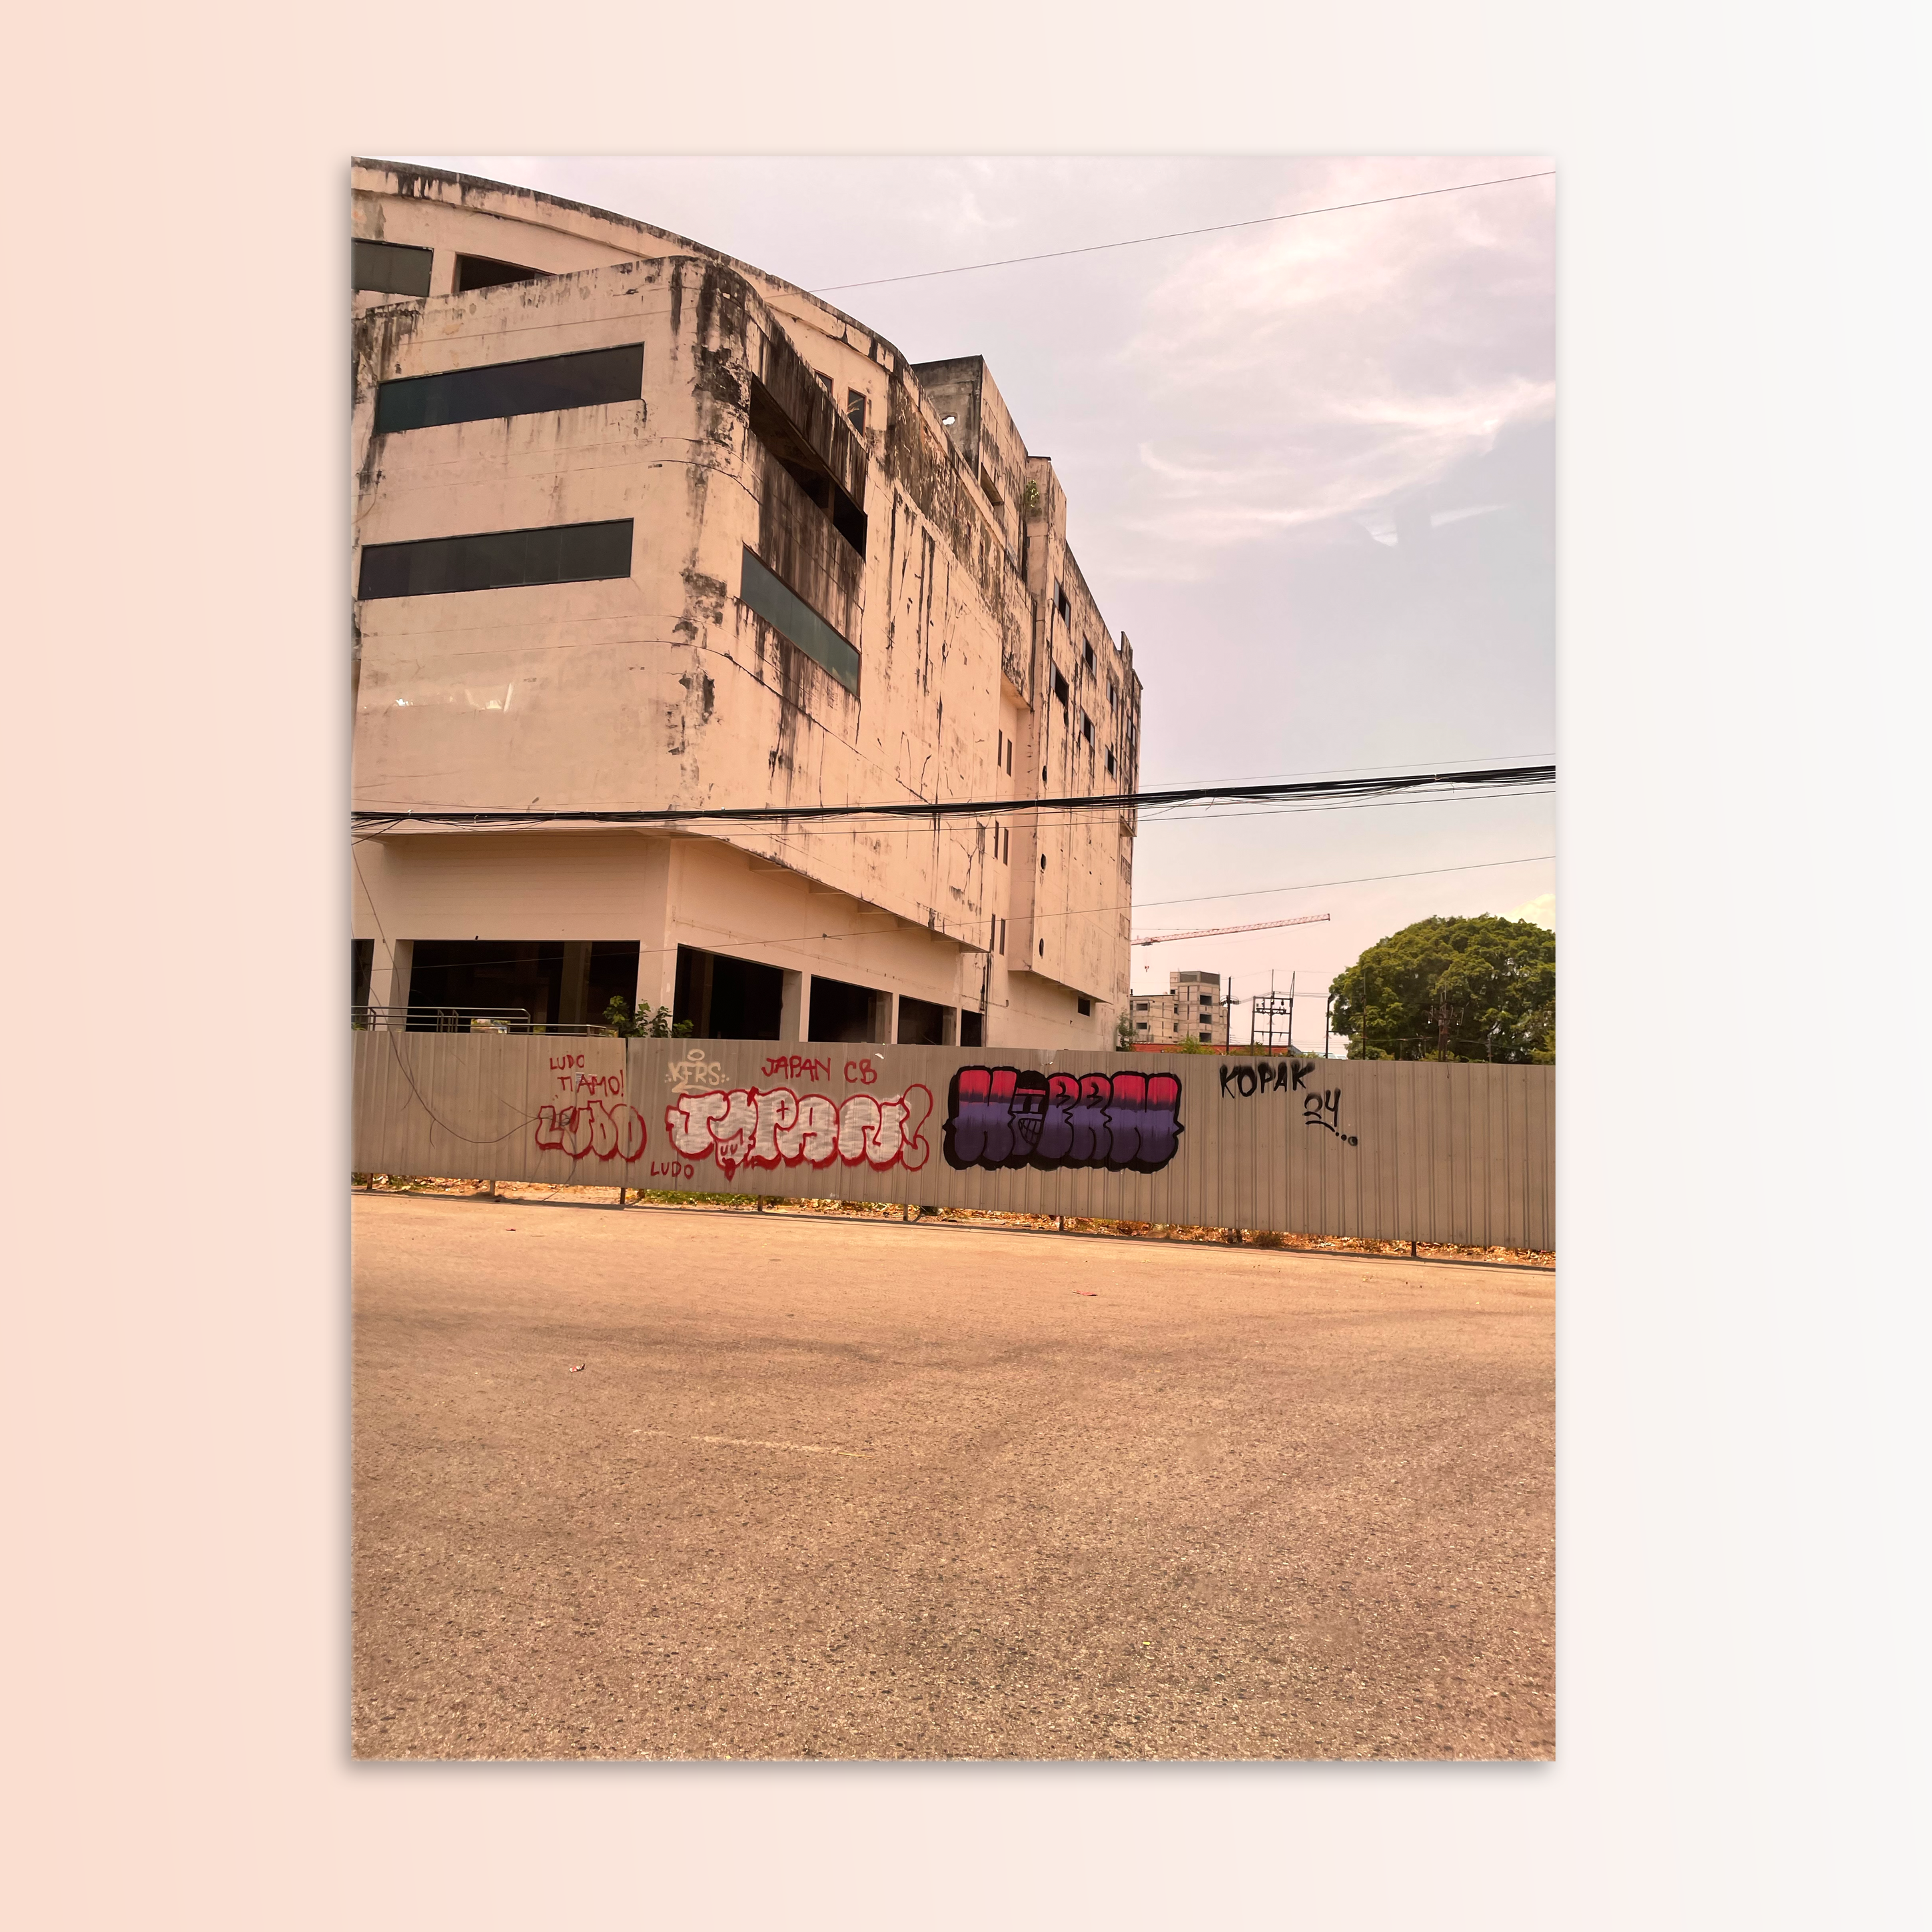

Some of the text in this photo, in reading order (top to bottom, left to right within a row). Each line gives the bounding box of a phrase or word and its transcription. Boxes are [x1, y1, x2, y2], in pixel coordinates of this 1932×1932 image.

[550, 1054, 585, 1071] LUDO
[761, 1056, 878, 1085] JAPAN CB
[1219, 1060, 1316, 1099] KOPAK
[535, 1100, 648, 1163] LUDO
[650, 1161, 695, 1180] LUDO
